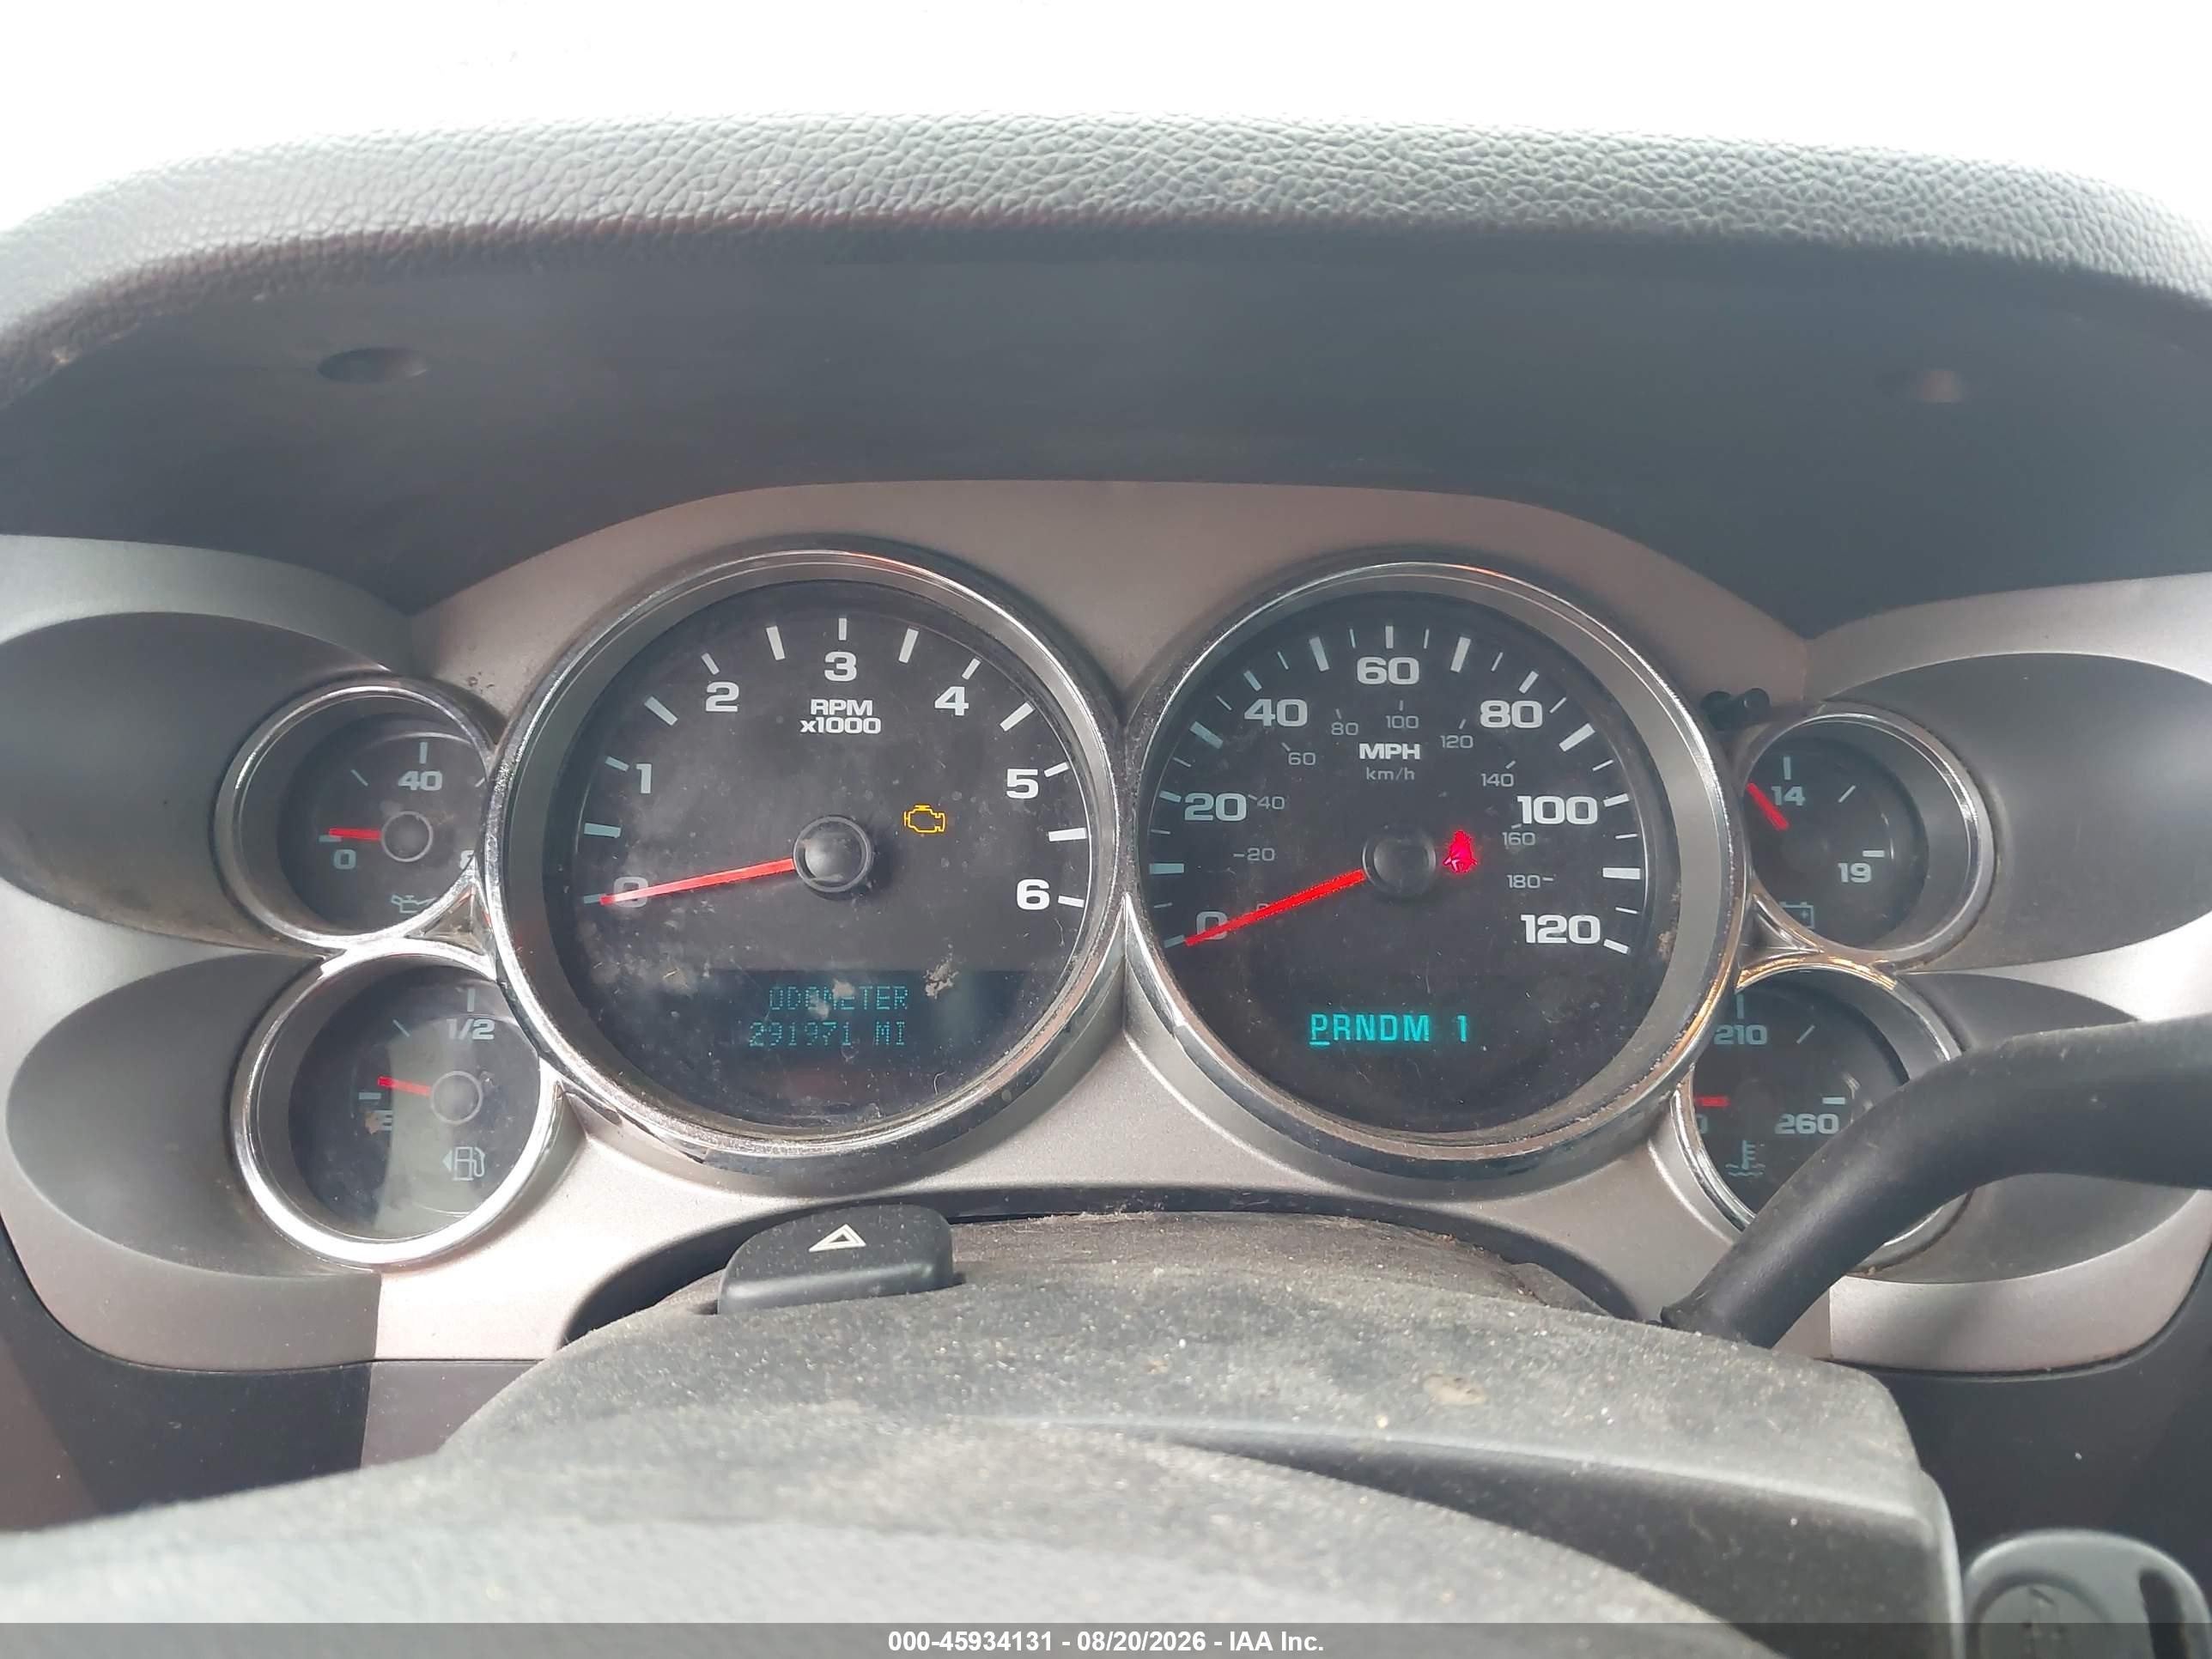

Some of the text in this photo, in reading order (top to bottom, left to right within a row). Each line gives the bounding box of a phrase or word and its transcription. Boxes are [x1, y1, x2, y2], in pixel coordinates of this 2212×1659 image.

[824, 652, 858, 682] 3
[1356, 656, 1419, 685] 60
[705, 682, 740, 713] 2
[810, 699, 873, 717] RPM
[934, 686, 969, 716] 4
[1243, 698, 1308, 728] 40
[1385, 715, 1419, 729] 100
[1480, 700, 1543, 729] 80
[799, 717, 881, 735] x1000
[1331, 722, 1359, 736] 80
[1358, 744, 1420, 760] MPH
[1441, 735, 1474, 749] 120
[1288, 751, 1316, 765] 60
[398, 771, 443, 791] 40
[635, 763, 652, 793] 1
[1006, 769, 1040, 799] 5
[1365, 766, 1415, 782] km/h
[1481, 772, 1515, 787] 140
[1256, 795, 1285, 810] 40
[1771, 785, 1805, 806] 14
[1184, 793, 1247, 822] 20
[1516, 795, 1598, 824] 100
[1502, 831, 1536, 846] 160
[332, 849, 356, 870] 0
[1248, 848, 1275, 861] 20
[1507, 874, 1540, 889] 180
[1838, 862, 1871, 883] 19
[613, 876, 649, 908] 0
[1016, 878, 1050, 910] 6
[1196, 911, 1228, 940] 0
[1519, 914, 1601, 945] 120
[769, 986, 908, 1011] ODOMETER
[446, 1018, 496, 1041] 1/2
[749, 1020, 905, 1047] 291971 MI
[1310, 1013, 1468, 1042] PRNDM 1
[1713, 1024, 1768, 1045] 210
[1774, 1113, 1839, 1134] 260
